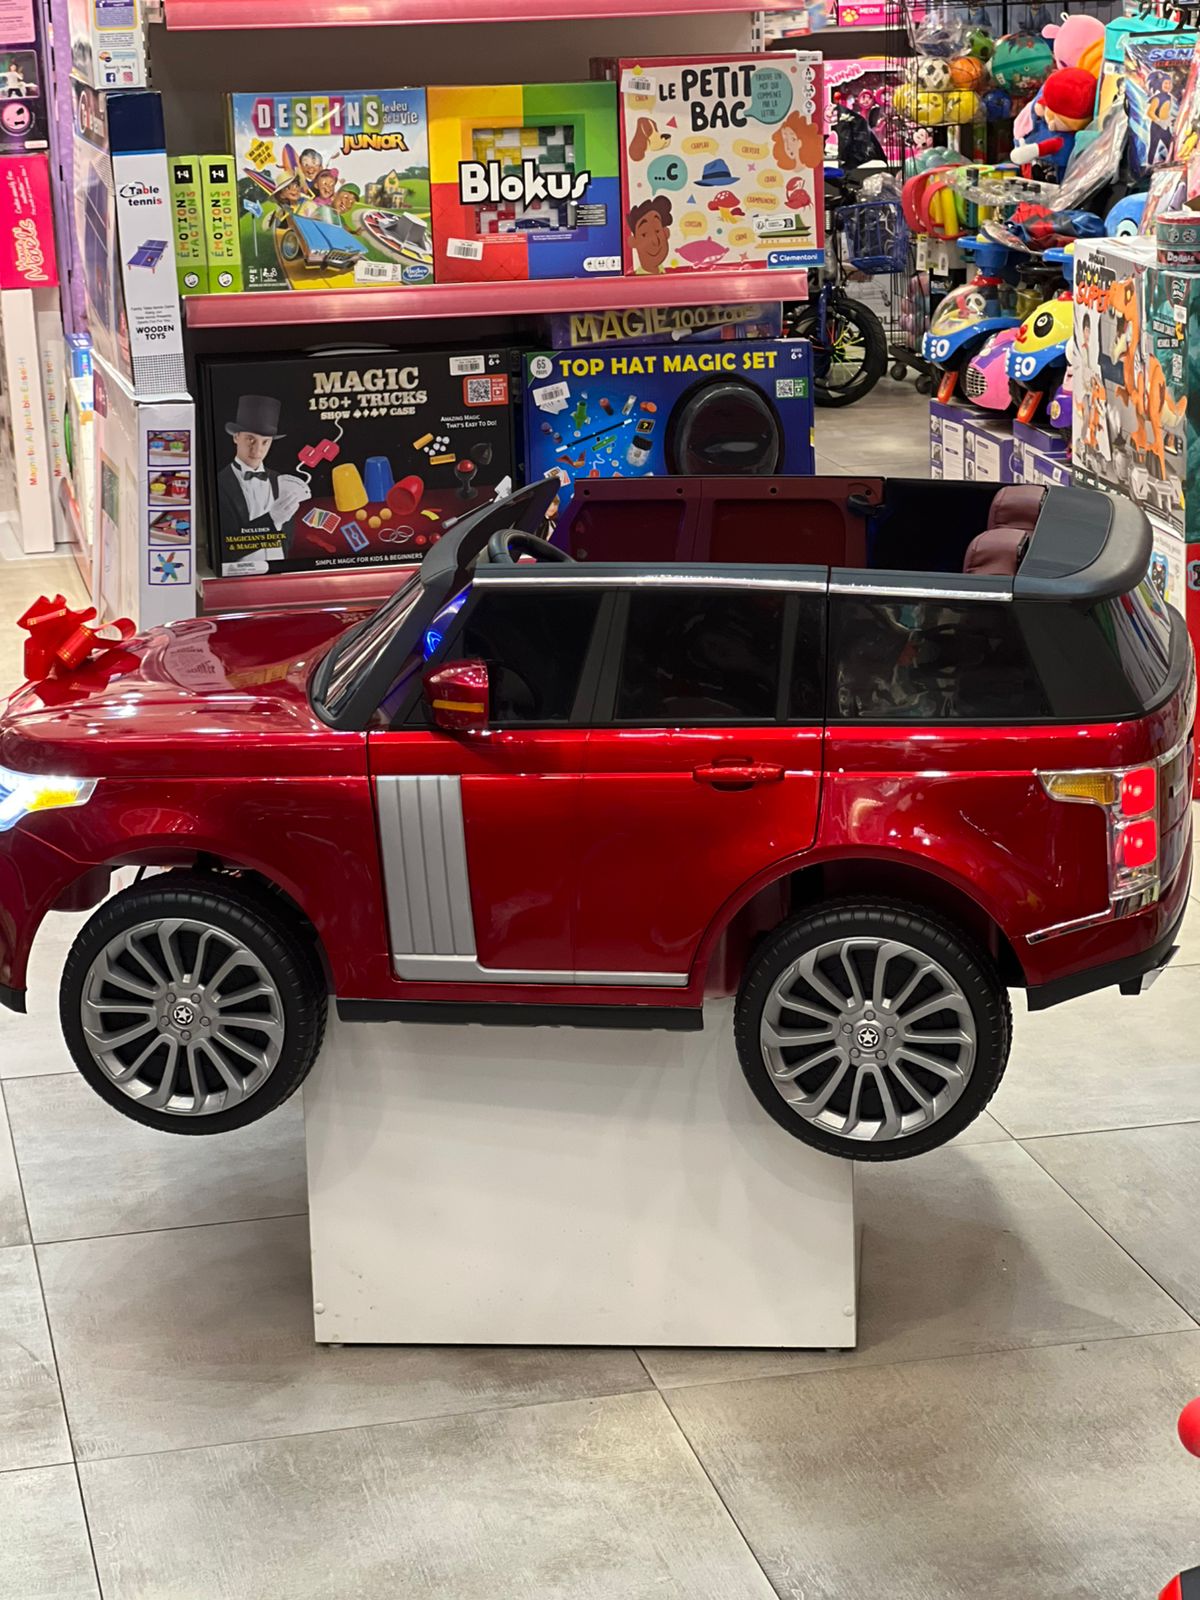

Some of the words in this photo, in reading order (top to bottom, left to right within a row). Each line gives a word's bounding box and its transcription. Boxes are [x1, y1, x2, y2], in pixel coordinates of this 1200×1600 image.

[659, 83, 676, 101] LE
[682, 65, 756, 101] PETIT
[257, 101, 379, 129] DESTINS
[691, 101, 747, 131] BAC
[341, 131, 409, 155] JUNIOR
[129, 186, 159, 195] Table
[461, 160, 590, 209] Blokus
[128, 197, 162, 206] tennis
[187, 191, 200, 246] ACTIONS
[222, 190, 234, 246] ACTIONS
[779, 254, 817, 262] Clementoni
[136, 325, 174, 334] WOODEN
[570, 307, 672, 347] MAGIE
[672, 308, 707, 328] 100
[488, 358, 500, 366] 6+
[536, 359, 546, 369] 65
[559, 358, 604, 377] TOP
[611, 356, 656, 375] HAT
[663, 352, 736, 372] MAGIC
[743, 351, 777, 370] SET
[312, 366, 419, 394] MAGIC
[308, 396, 351, 410] 150+
[357, 390, 428, 407] TRICKS
[320, 410, 350, 420] SHOW
[390, 407, 416, 415] CASE
[225, 534, 265, 542] MAGICIAN'S
[390, 552, 423, 560] BEGINNERS
